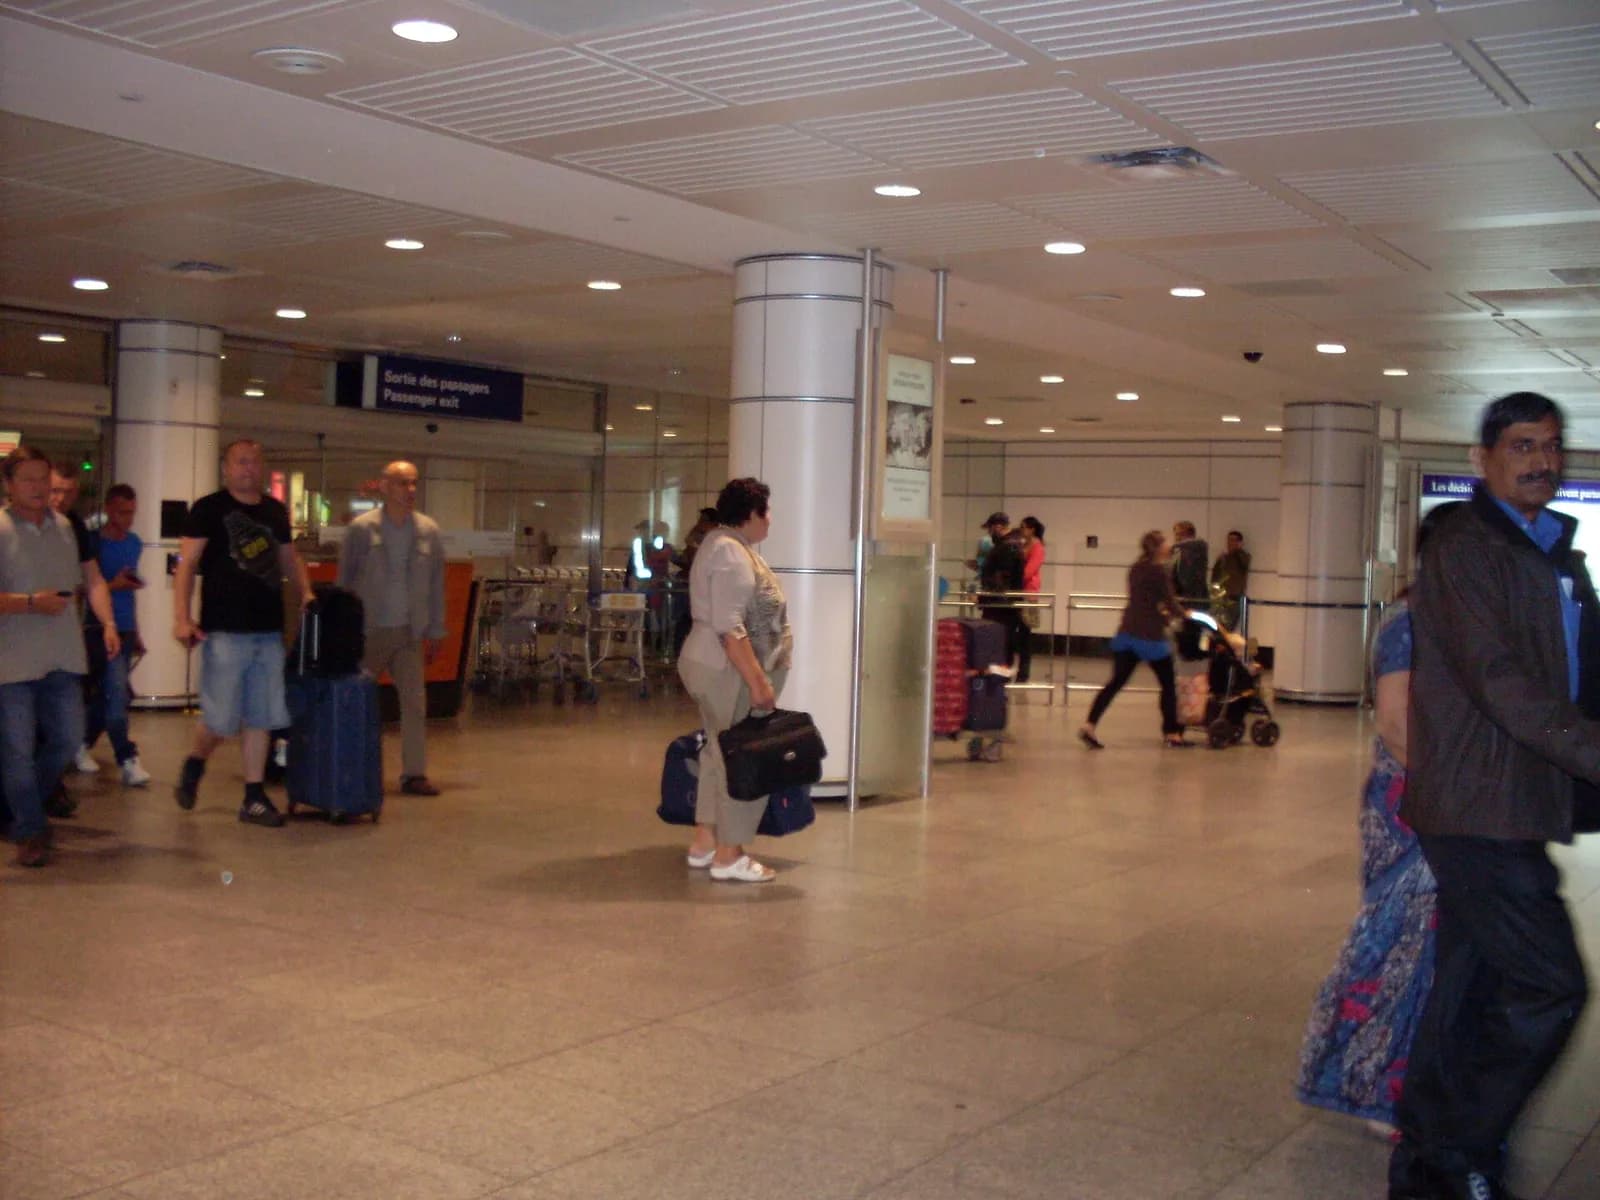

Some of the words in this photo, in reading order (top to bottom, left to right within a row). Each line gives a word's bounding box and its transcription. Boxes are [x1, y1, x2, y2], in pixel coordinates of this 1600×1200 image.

[384, 369, 417, 386] Sortie
[420, 374, 438, 389] des
[384, 387, 437, 407] Passenger
[439, 395, 460, 408] exit
